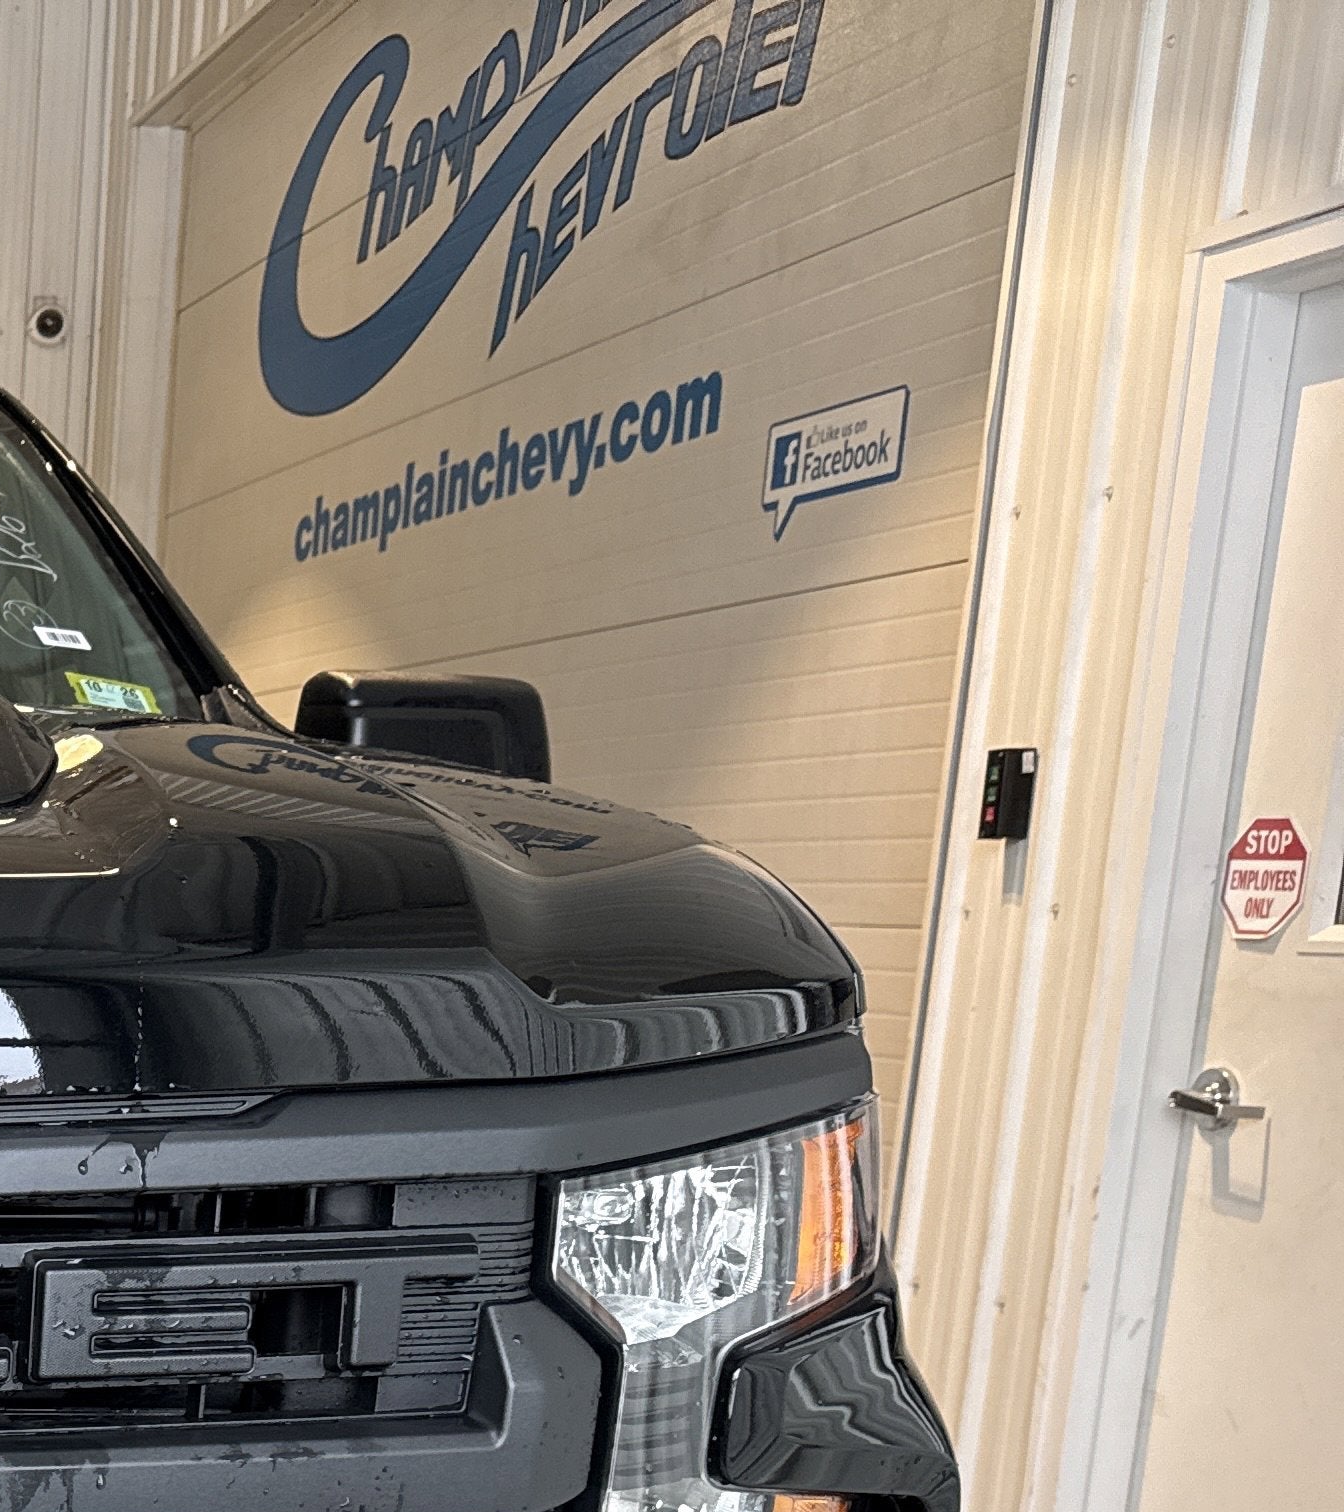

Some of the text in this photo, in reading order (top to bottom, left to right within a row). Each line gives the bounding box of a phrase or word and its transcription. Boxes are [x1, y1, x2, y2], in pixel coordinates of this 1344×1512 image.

[842, 422, 853, 437] us
[855, 420, 868, 435] on
[294, 371, 723, 562] champlainchevy.com
[802, 429, 891, 483] Facebook
[1245, 829, 1293, 855] STOP
[1230, 869, 1297, 892] EMPLOYEES
[1244, 897, 1274, 919] ONLY
